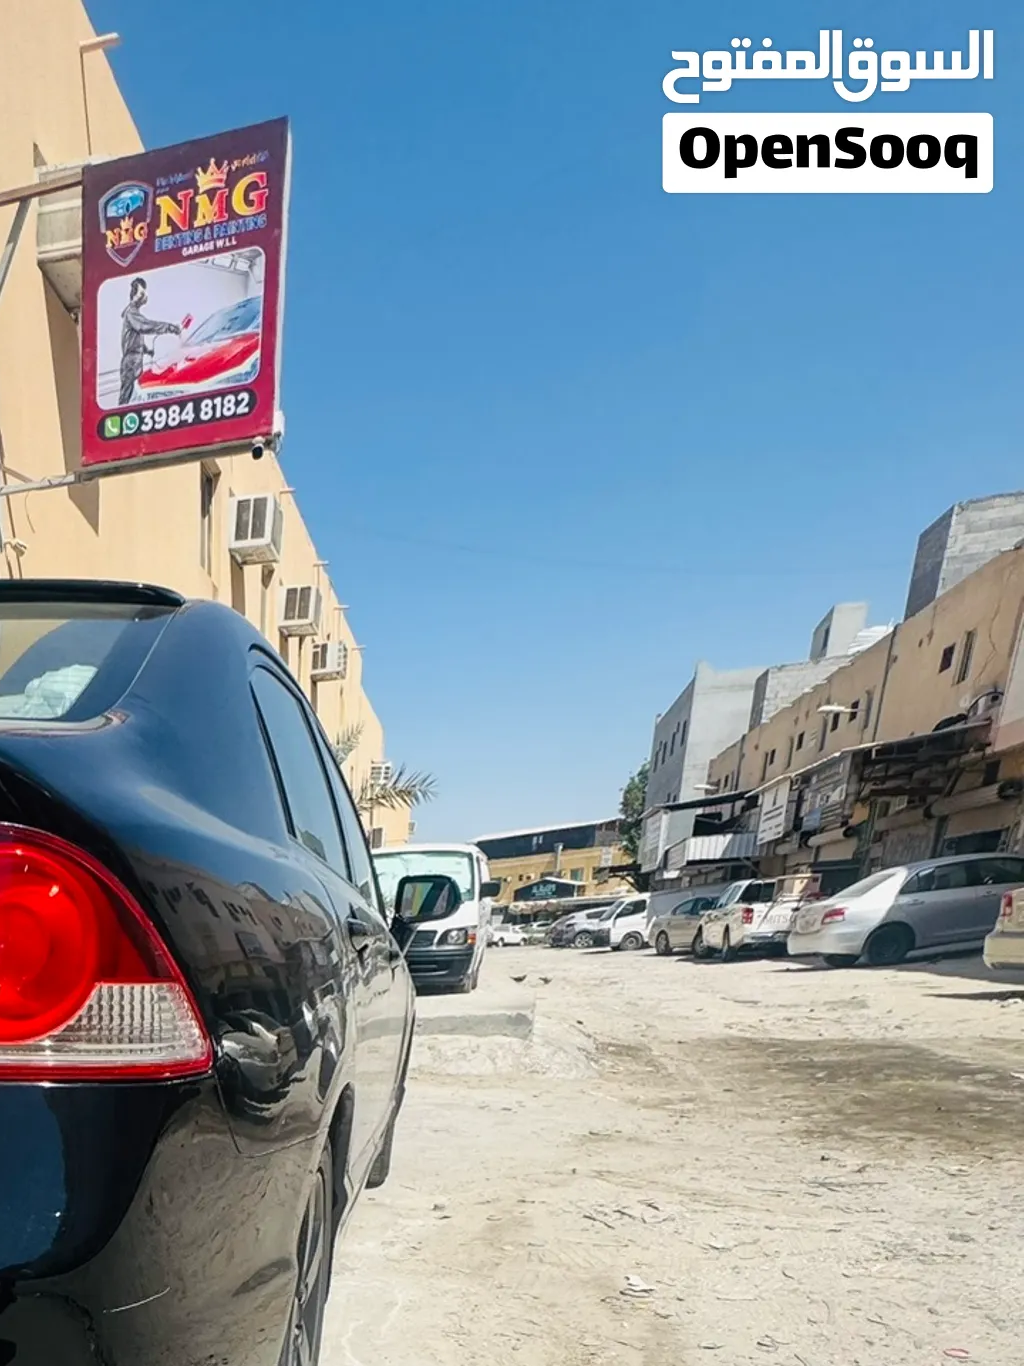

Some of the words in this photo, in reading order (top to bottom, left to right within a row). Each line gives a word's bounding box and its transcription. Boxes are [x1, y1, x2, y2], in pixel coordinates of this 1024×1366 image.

[155, 171, 269, 236] NMG
[213, 213, 268, 239] PAINTING
[181, 240, 215, 257] GARAGE
[140, 403, 195, 432] 3984
[200, 391, 250, 421] 8182
